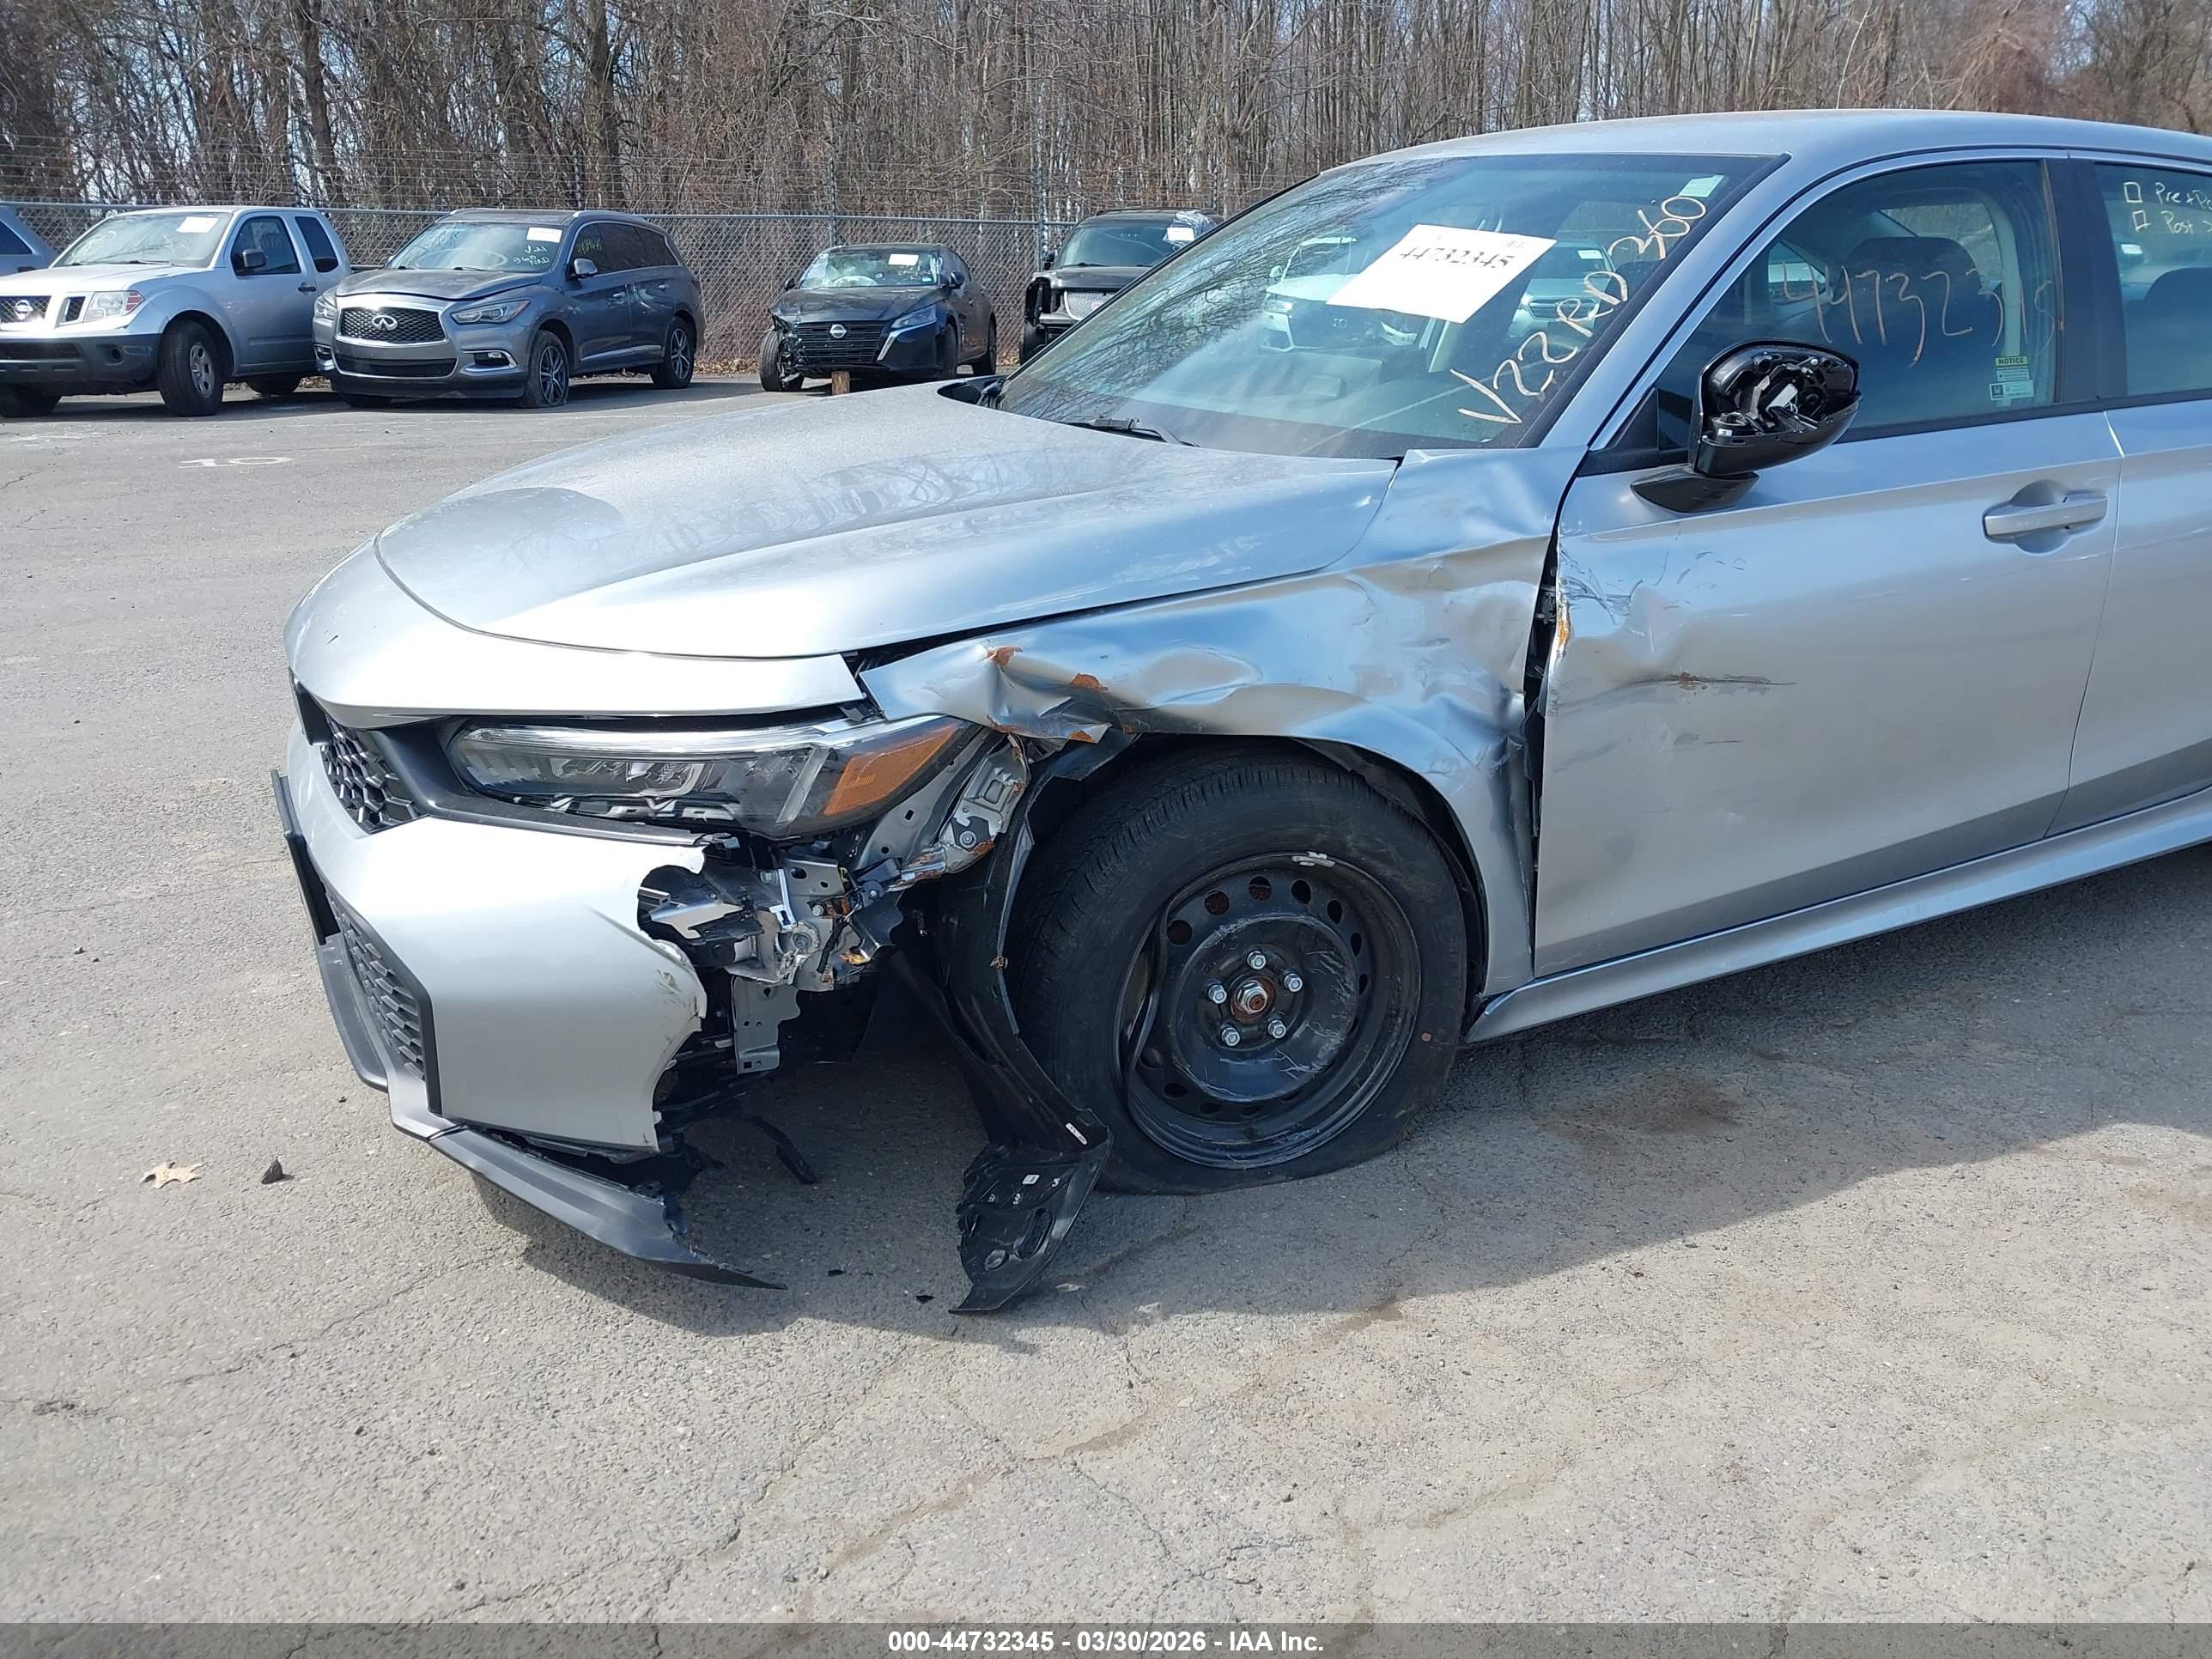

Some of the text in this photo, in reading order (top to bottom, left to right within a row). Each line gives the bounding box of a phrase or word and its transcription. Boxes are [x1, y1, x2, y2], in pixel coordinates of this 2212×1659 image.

[2154, 182, 2181, 204] Pre
[1608, 196, 1707, 260] 360
[2160, 211, 2194, 234] Post
[1400, 246, 1516, 269] 44732345
